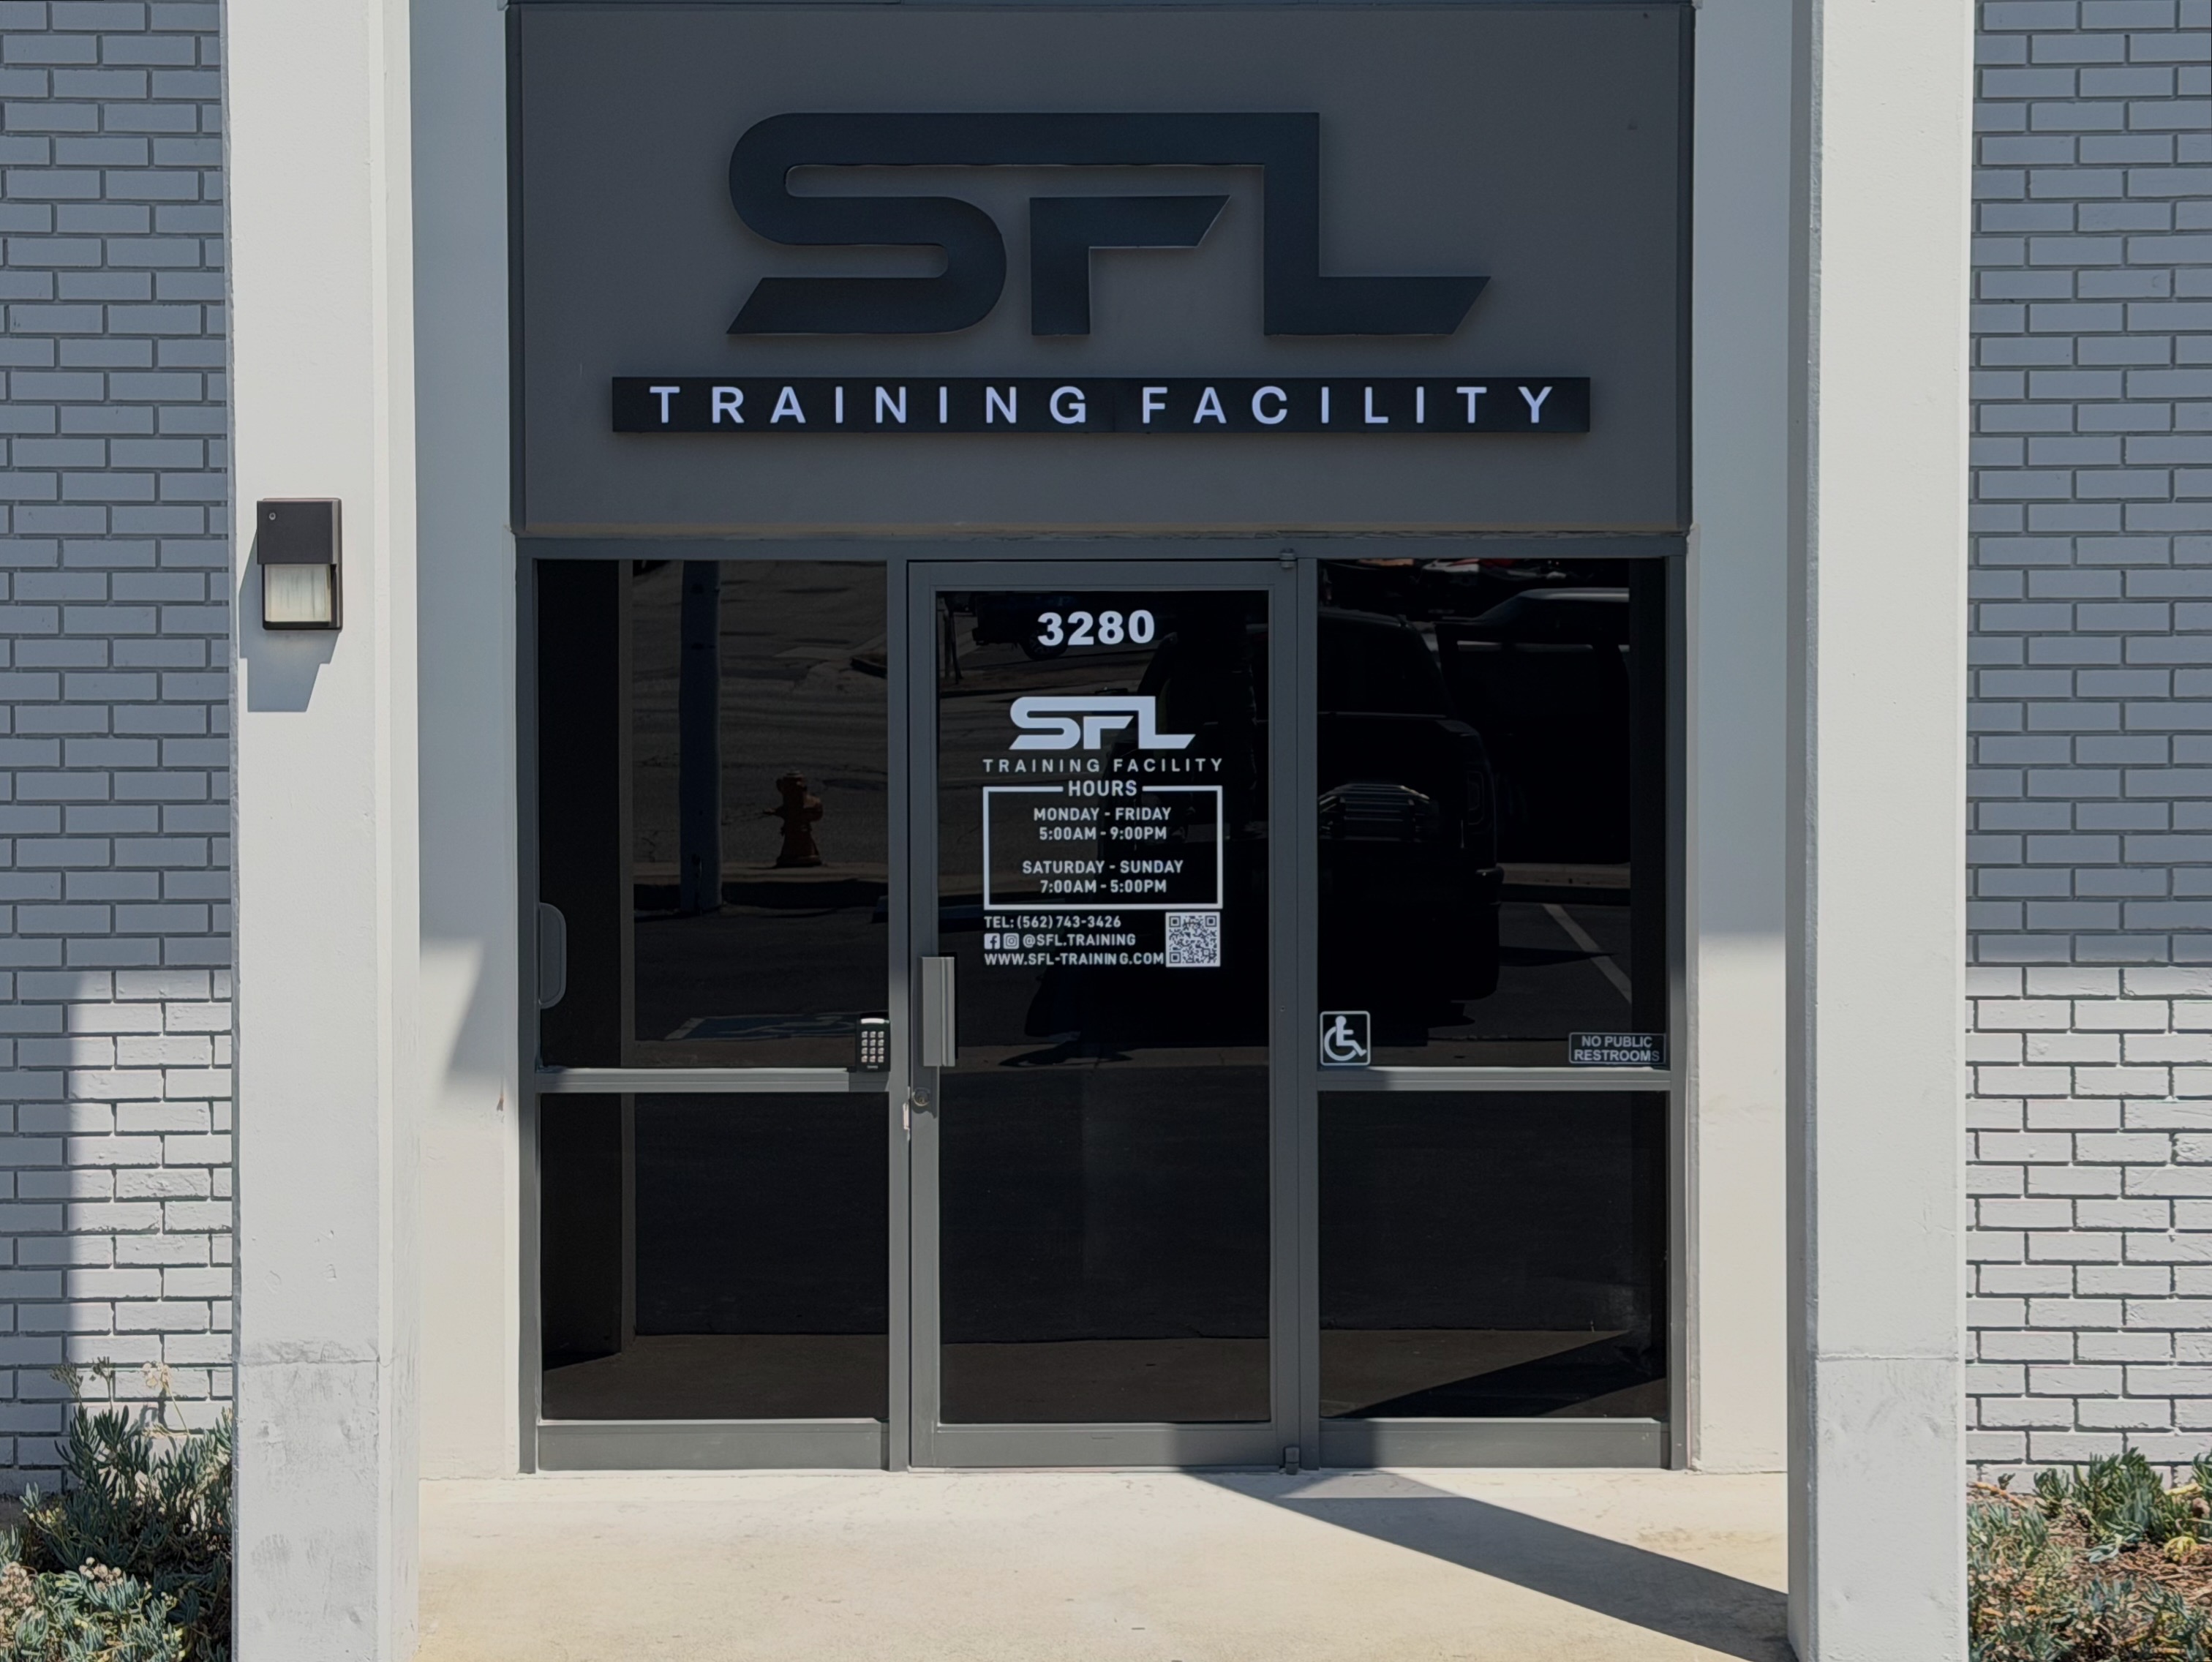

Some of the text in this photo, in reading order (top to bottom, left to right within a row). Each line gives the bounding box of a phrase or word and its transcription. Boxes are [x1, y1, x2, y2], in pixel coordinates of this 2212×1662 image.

[726, 112, 1491, 335] SFL
[650, 386, 1551, 424] TRAINING FACILITY
[1038, 610, 1154, 646] 3280
[1009, 696, 1195, 750] SFL
[983, 759, 1222, 772] TRAINING FACILITY
[1069, 780, 1137, 796] HOURS
[1034, 808, 1099, 821] MONDAY
[1116, 808, 1170, 820] FRIDAY
[1040, 827, 1096, 840] 5:00AM
[1110, 827, 1166, 839] 9:00PM
[1023, 861, 1104, 873] SATURDAY
[1121, 860, 1183, 873] SUNDAY
[1041, 880, 1096, 892] 7:00AM
[1111, 880, 1166, 892] 5:00PM
[985, 916, 1121, 928] TEL: (562) 743-3426
[1023, 934, 1135, 948] @SFL.TRAINING
[985, 952, 1163, 965] WWW.SFL-TRAINING.COM
[1582, 1036, 1652, 1048] NO PUBLIC
[1574, 1050, 1660, 1061] RESTROOMS
